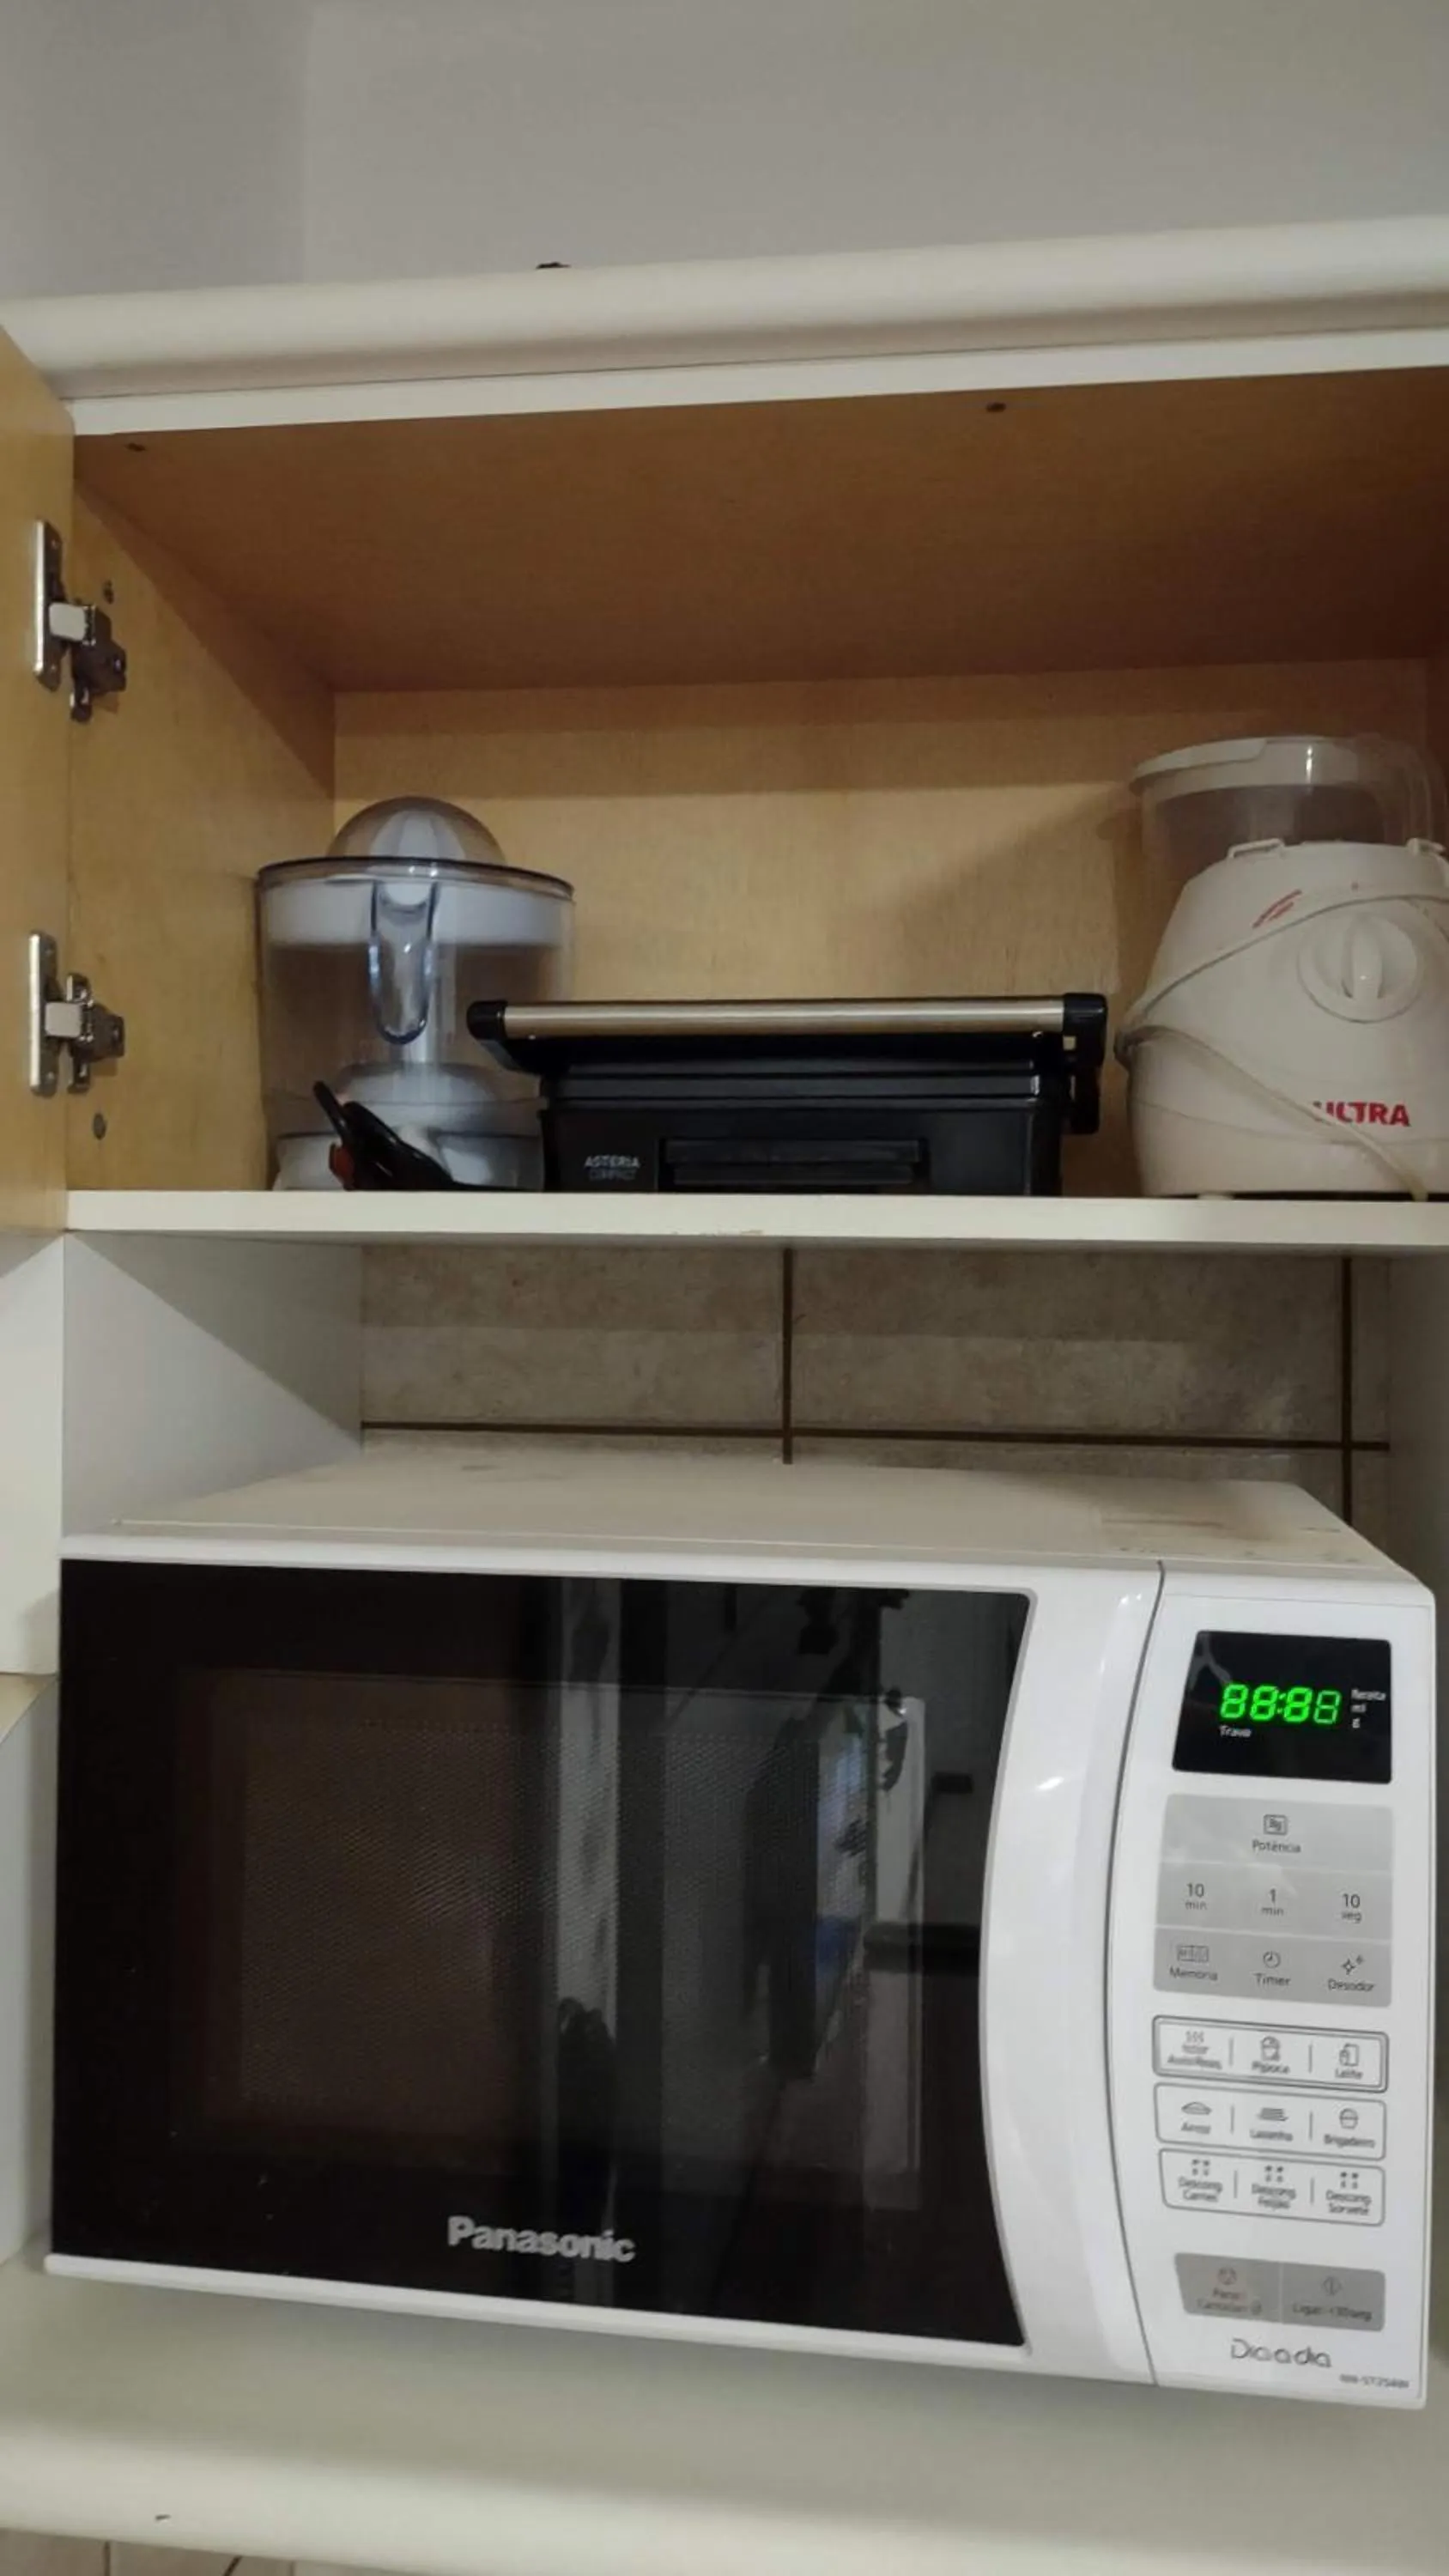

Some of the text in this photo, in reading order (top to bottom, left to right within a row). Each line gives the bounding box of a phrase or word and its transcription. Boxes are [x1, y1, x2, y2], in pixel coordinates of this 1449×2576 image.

[585, 1155, 640, 1169] ASTERIA
[1219, 1724, 1252, 1738] Trava
[1252, 1838, 1301, 1854] Potência
[1186, 1883, 1205, 1898] 10
[1269, 1889, 1276, 1904] 1
[1185, 1900, 1208, 1911] min
[1343, 1893, 1361, 1909] 10
[1261, 1905, 1284, 1917] min
[1341, 1911, 1362, 1923] seg
[1253, 1972, 1290, 1987] Timer
[1327, 1978, 1376, 1992] Desodor
[1335, 2069, 1363, 2080] Leite
[447, 2215, 636, 2263] Panasonic
